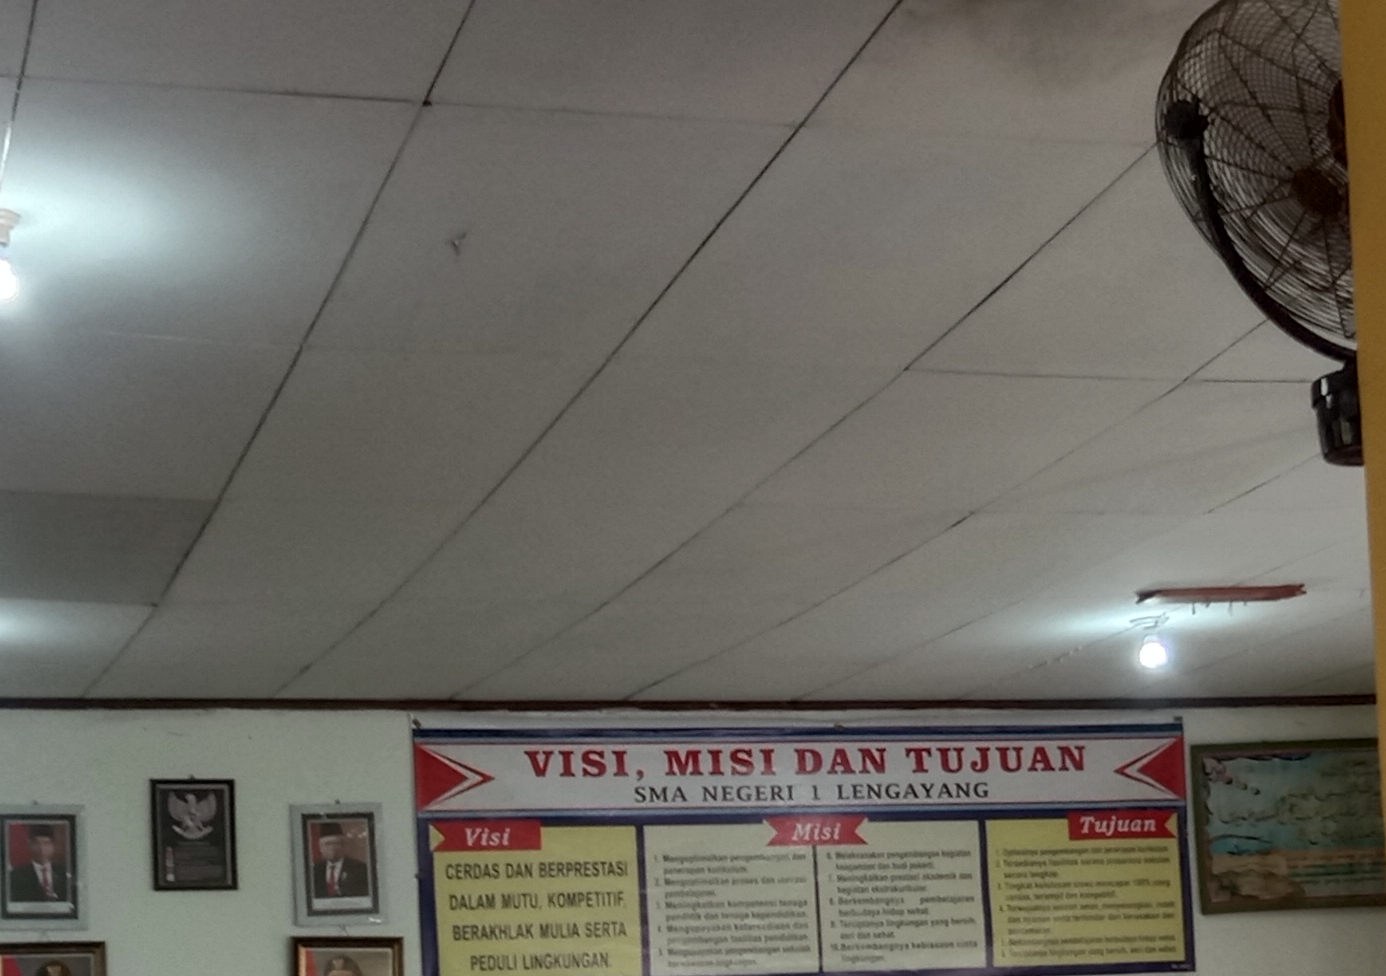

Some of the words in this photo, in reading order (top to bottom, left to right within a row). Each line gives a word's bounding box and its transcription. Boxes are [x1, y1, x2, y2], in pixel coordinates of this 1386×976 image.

[523, 749, 645, 781] VISI,
[663, 748, 776, 776] MISI
[793, 747, 887, 775] DAN
[905, 745, 1086, 774] TUJUAN
[633, 786, 688, 803] SMA
[701, 784, 794, 801] NEGERI
[811, 784, 820, 801] 1
[837, 782, 989, 800] LENGAYANG
[791, 823, 841, 841] Misi
[1080, 816, 1156, 836] Tujuan
[465, 828, 510, 846] Visi
[446, 863, 499, 879] CERDAS
[506, 863, 533, 878] DAN
[539, 861, 628, 877] BERPRESTASI
[449, 893, 495, 910] DALAM
[453, 924, 533, 940] BERAKHLAK
[540, 923, 579, 939] MULIA
[585, 922, 627, 938] SERTA
[470, 954, 517, 971] PEDULI
